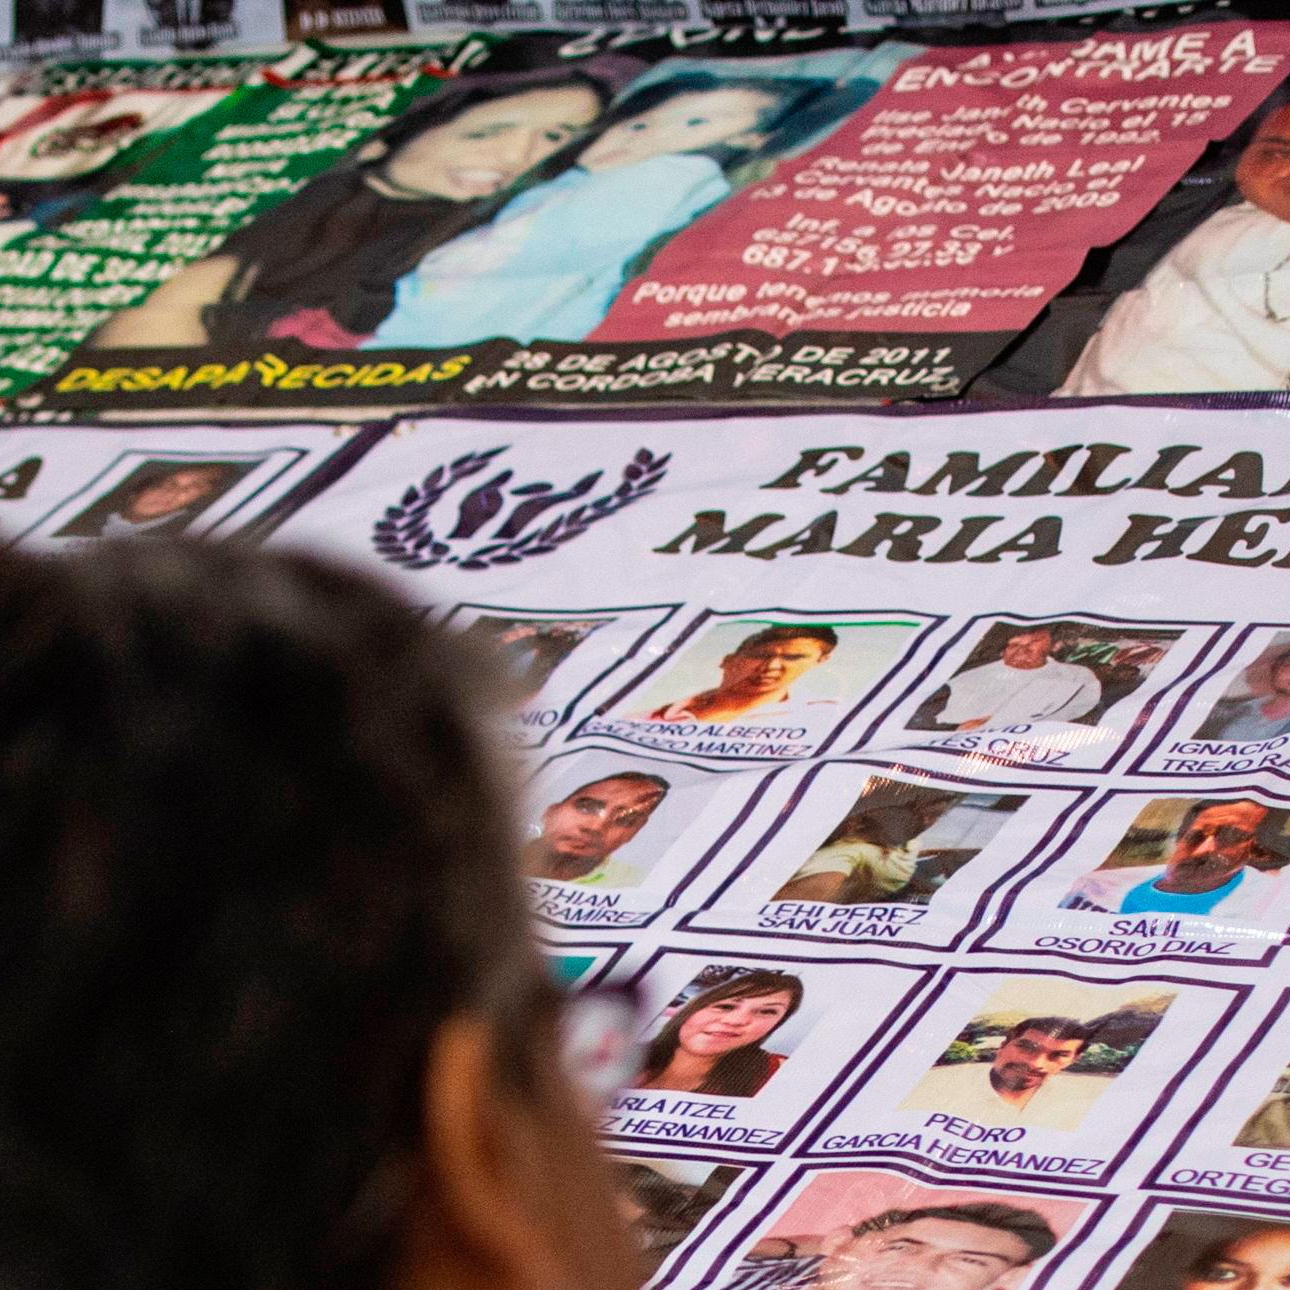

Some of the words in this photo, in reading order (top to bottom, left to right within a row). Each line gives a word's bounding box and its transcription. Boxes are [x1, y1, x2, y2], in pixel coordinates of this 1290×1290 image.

[1060, 94, 1232, 116] Cervantes
[940, 160, 1057, 182] Janeth
[633, 280, 747, 306] Porque
[503, 349, 551, 371] 28
[555, 352, 617, 372] DE
[620, 343, 784, 371] AGOSTO
[789, 347, 852, 366] DE
[859, 346, 953, 366] 2011
[55, 353, 474, 395] DESAPARECIDAS
[525, 364, 716, 393] CORDOBA
[733, 359, 962, 394] VERACRUZ
[653, 509, 1063, 563] MARIA
[702, 725, 808, 741] ALBERTO
[691, 742, 813, 758] MARTINEZ
[987, 738, 1072, 766] CRUZ
[1168, 735, 1287, 757] IGNACIO
[1161, 757, 1255, 774] TREJO
[758, 917, 821, 931] SAN
[822, 921, 903, 937] JUAN
[1034, 936, 1157, 957] OSORIO
[1160, 940, 1237, 955] DIAZ
[670, 1101, 739, 1121] ITZEL
[621, 1118, 785, 1148] HERNANDEZ
[926, 1112, 1028, 1144] PEDRO
[822, 1132, 922, 1153] GARCIA
[927, 1138, 1105, 1176] HERNANDEZ
